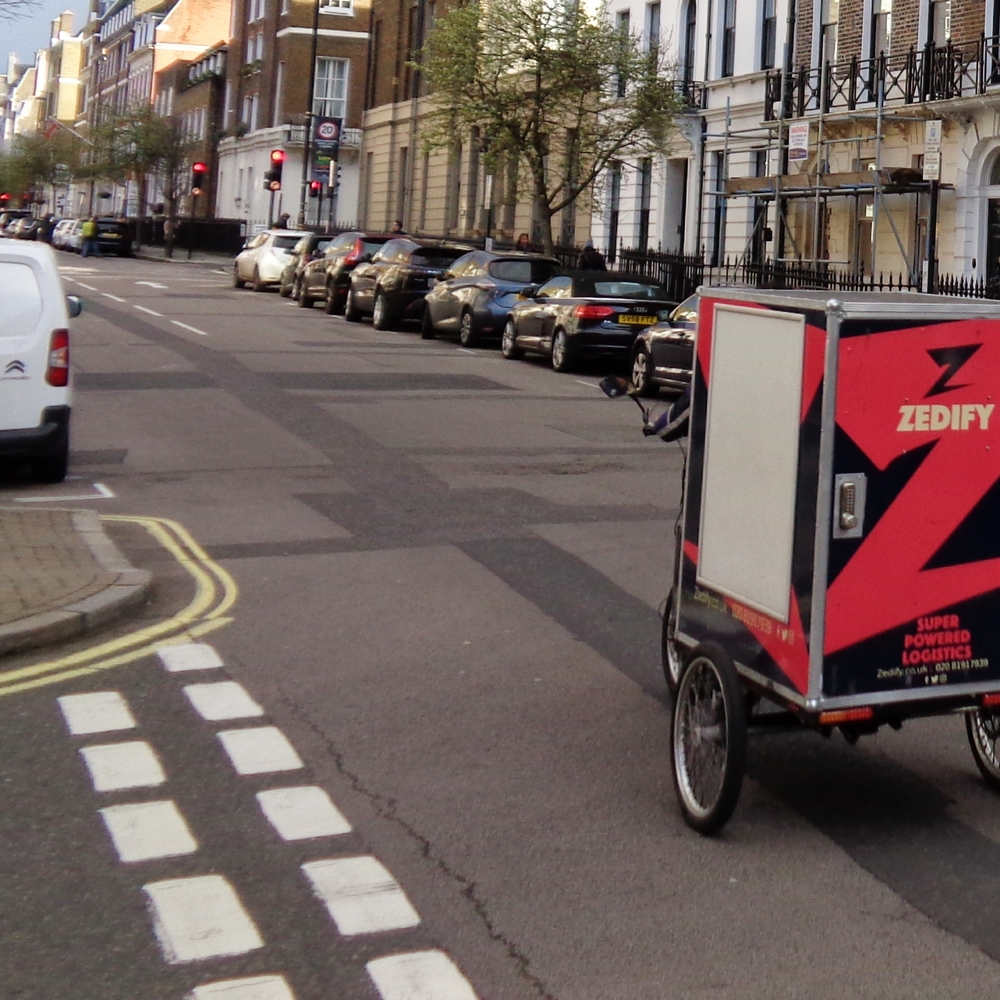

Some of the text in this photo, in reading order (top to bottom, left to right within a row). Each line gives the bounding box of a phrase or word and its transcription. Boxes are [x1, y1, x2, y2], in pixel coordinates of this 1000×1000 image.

[321, 125, 334, 135] 20
[896, 404, 996, 432] ZEDIFY
[917, 614, 960, 632] SUPER
[904, 629, 971, 648] POWERED
[901, 645, 973, 666] LOGISTICS
